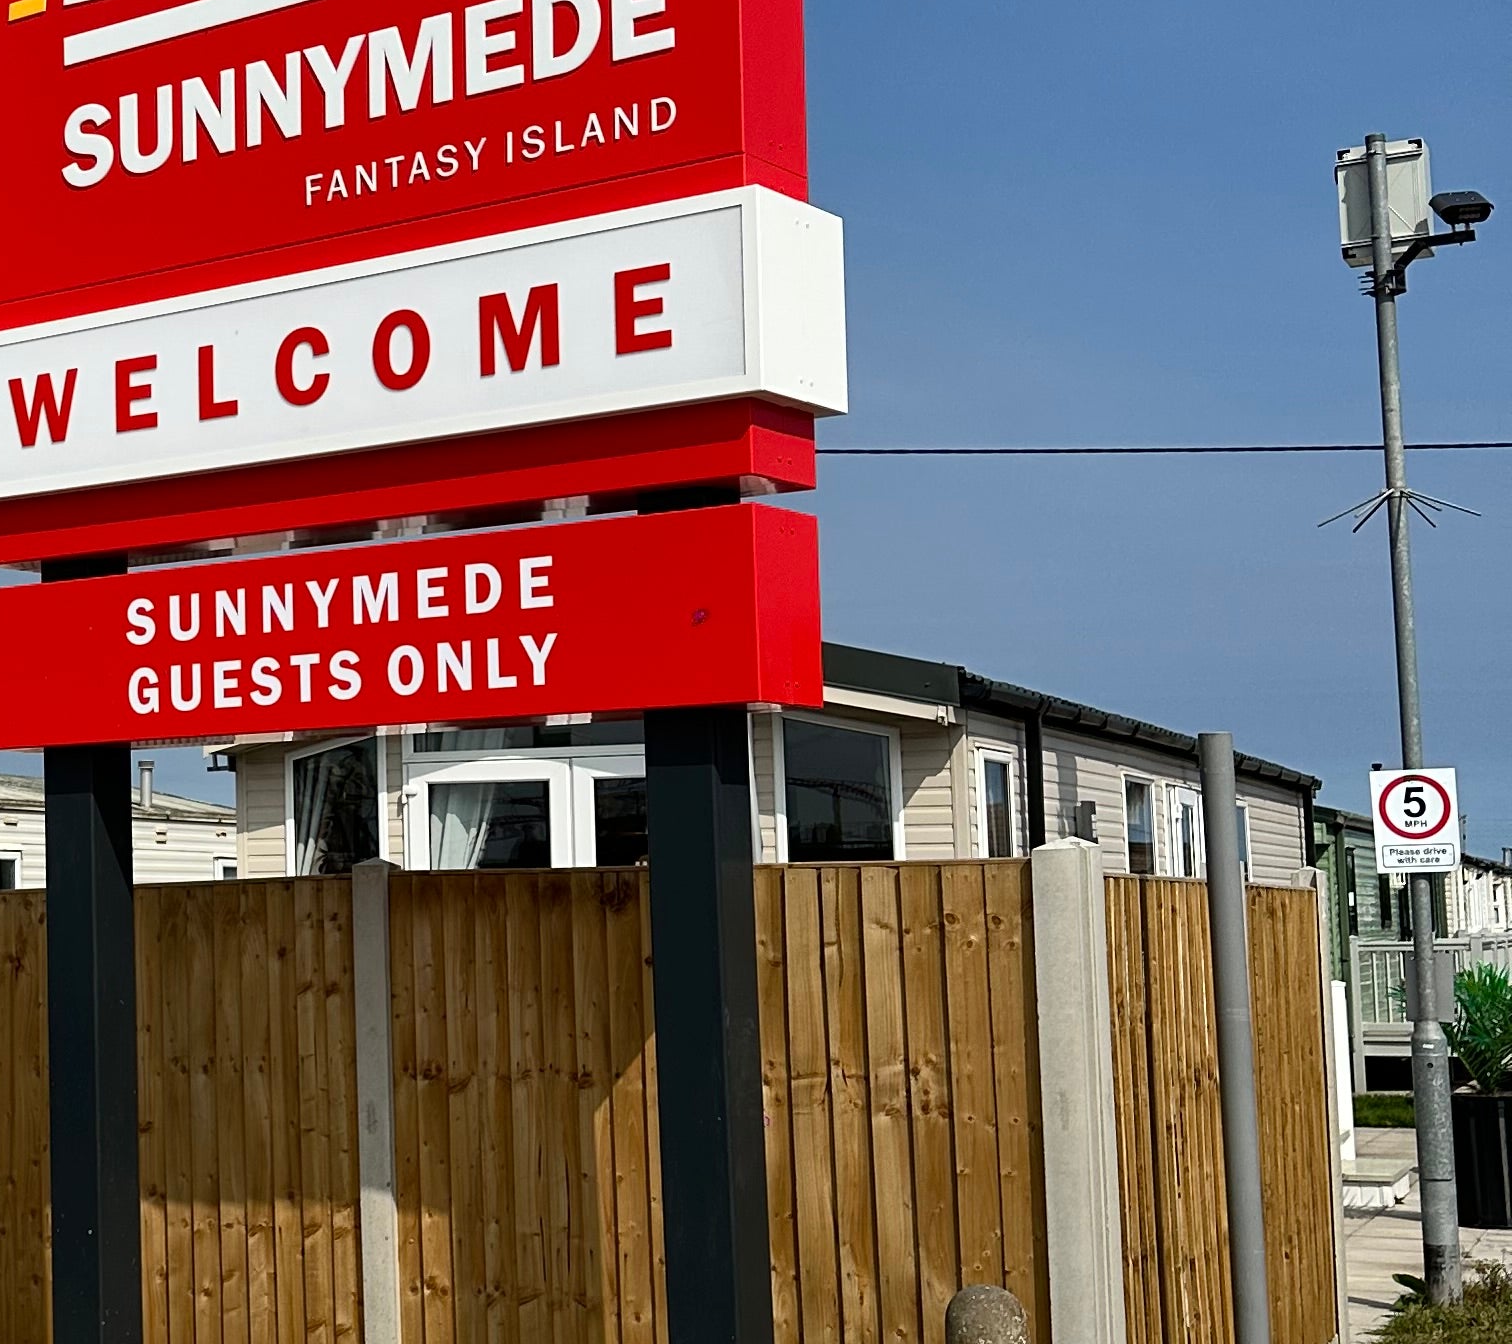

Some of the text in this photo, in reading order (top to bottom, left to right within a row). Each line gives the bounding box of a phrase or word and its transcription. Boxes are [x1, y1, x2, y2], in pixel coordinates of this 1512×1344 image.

[305, 96, 678, 207] FANTASY ISLAND
[8, 262, 674, 448] WELCOME
[125, 555, 555, 646] SUNNYMEDE
[128, 632, 558, 715] GUESTS ONLY
[1403, 786, 1426, 818] 5
[1404, 820, 1428, 828] MPH
[1389, 847, 1447, 856] Please drive
